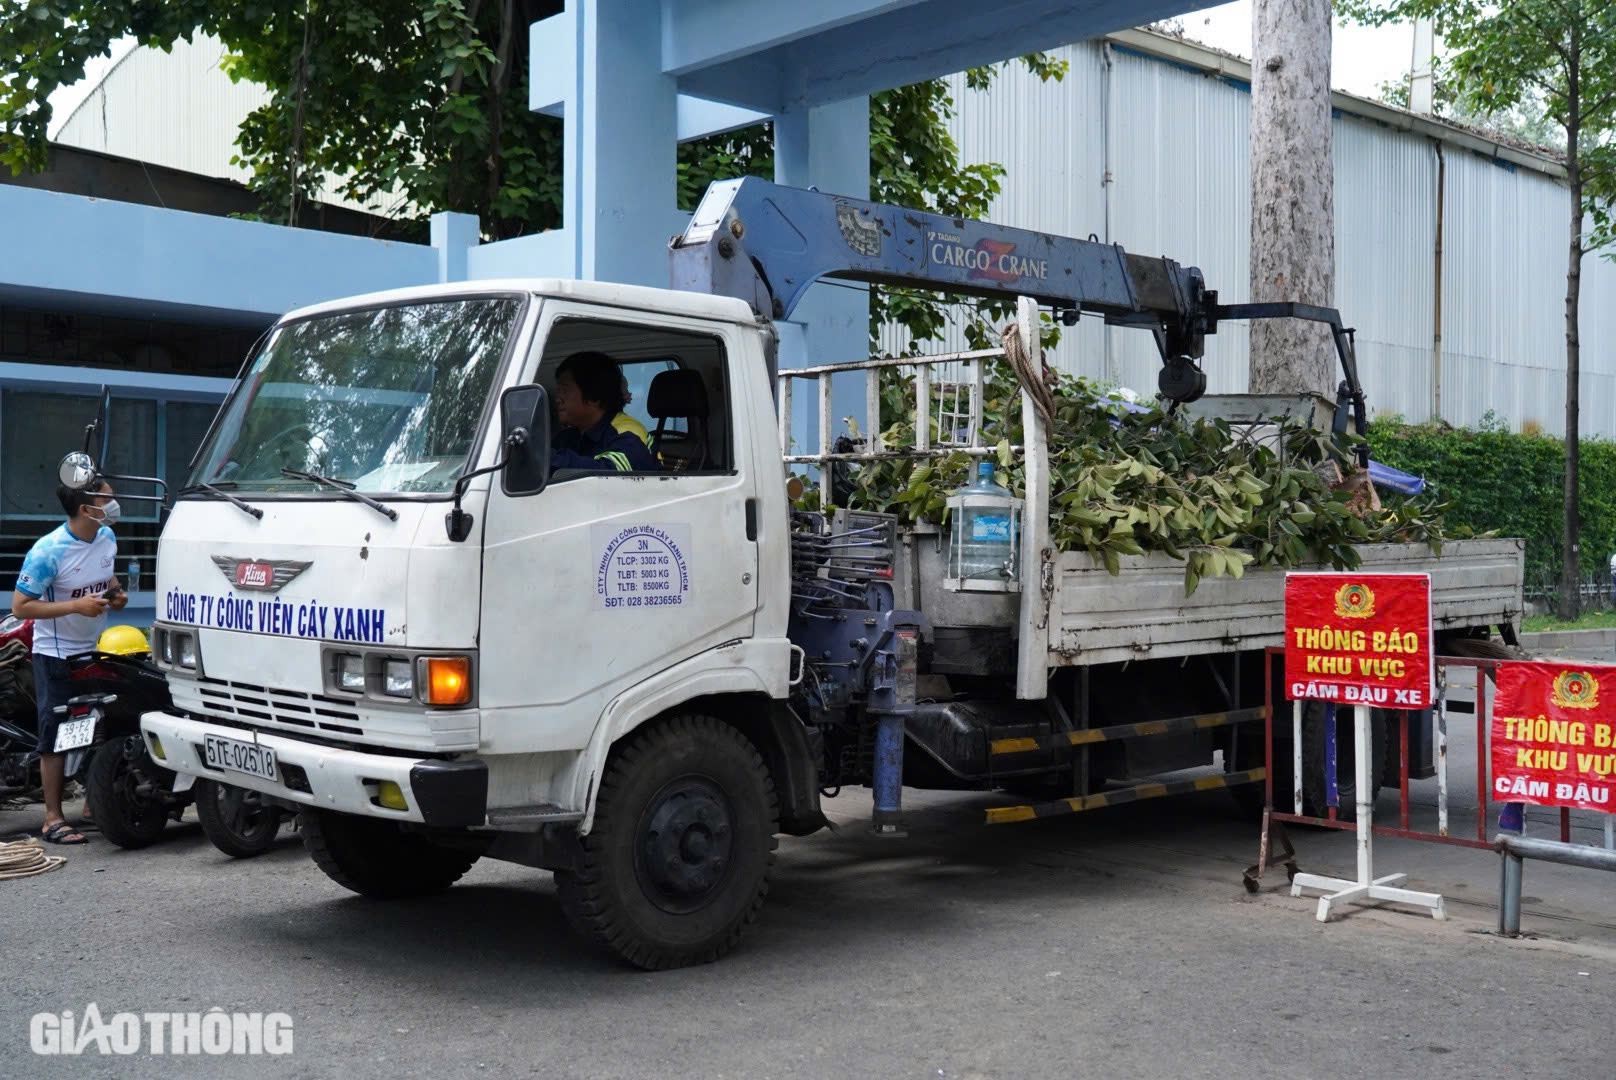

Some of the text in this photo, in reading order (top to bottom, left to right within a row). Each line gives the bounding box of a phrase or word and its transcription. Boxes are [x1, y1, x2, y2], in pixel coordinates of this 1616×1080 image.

[937, 232, 960, 243] TADANO
[931, 244, 1048, 280] CARGO CRANE
[637, 539, 649, 551] 3N
[599, 553, 610, 576] TNHH
[606, 537, 619, 552] MTV
[619, 526, 638, 540] CÔNG
[639, 525, 655, 534] VIÊN
[655, 530, 669, 542] CÂY
[667, 540, 683, 561] XANH
[680, 561, 689, 591] TP.HCM
[617, 555, 669, 566] TLCP: 3302 KG
[241, 564, 266, 586] Hino
[617, 570, 638, 579] TLBT:
[658, 569, 669, 578] KG
[617, 583, 638, 592] TLTB:
[605, 595, 682, 608] SĐT: 028 38236565
[167, 586, 385, 643] CÔNG TY CÔNG VIÊN CÂY XANH
[1294, 624, 1419, 654] THÔNG BÁO
[1306, 655, 1406, 681] KHU VỰC
[1345, 684, 1388, 705] ĐẬU
[1394, 689, 1422, 705] XE
[1503, 714, 1586, 746] THÔNG
[1516, 748, 1616, 780] KHU VỰ
[1495, 775, 1609, 805] CẤM ĐẬU
